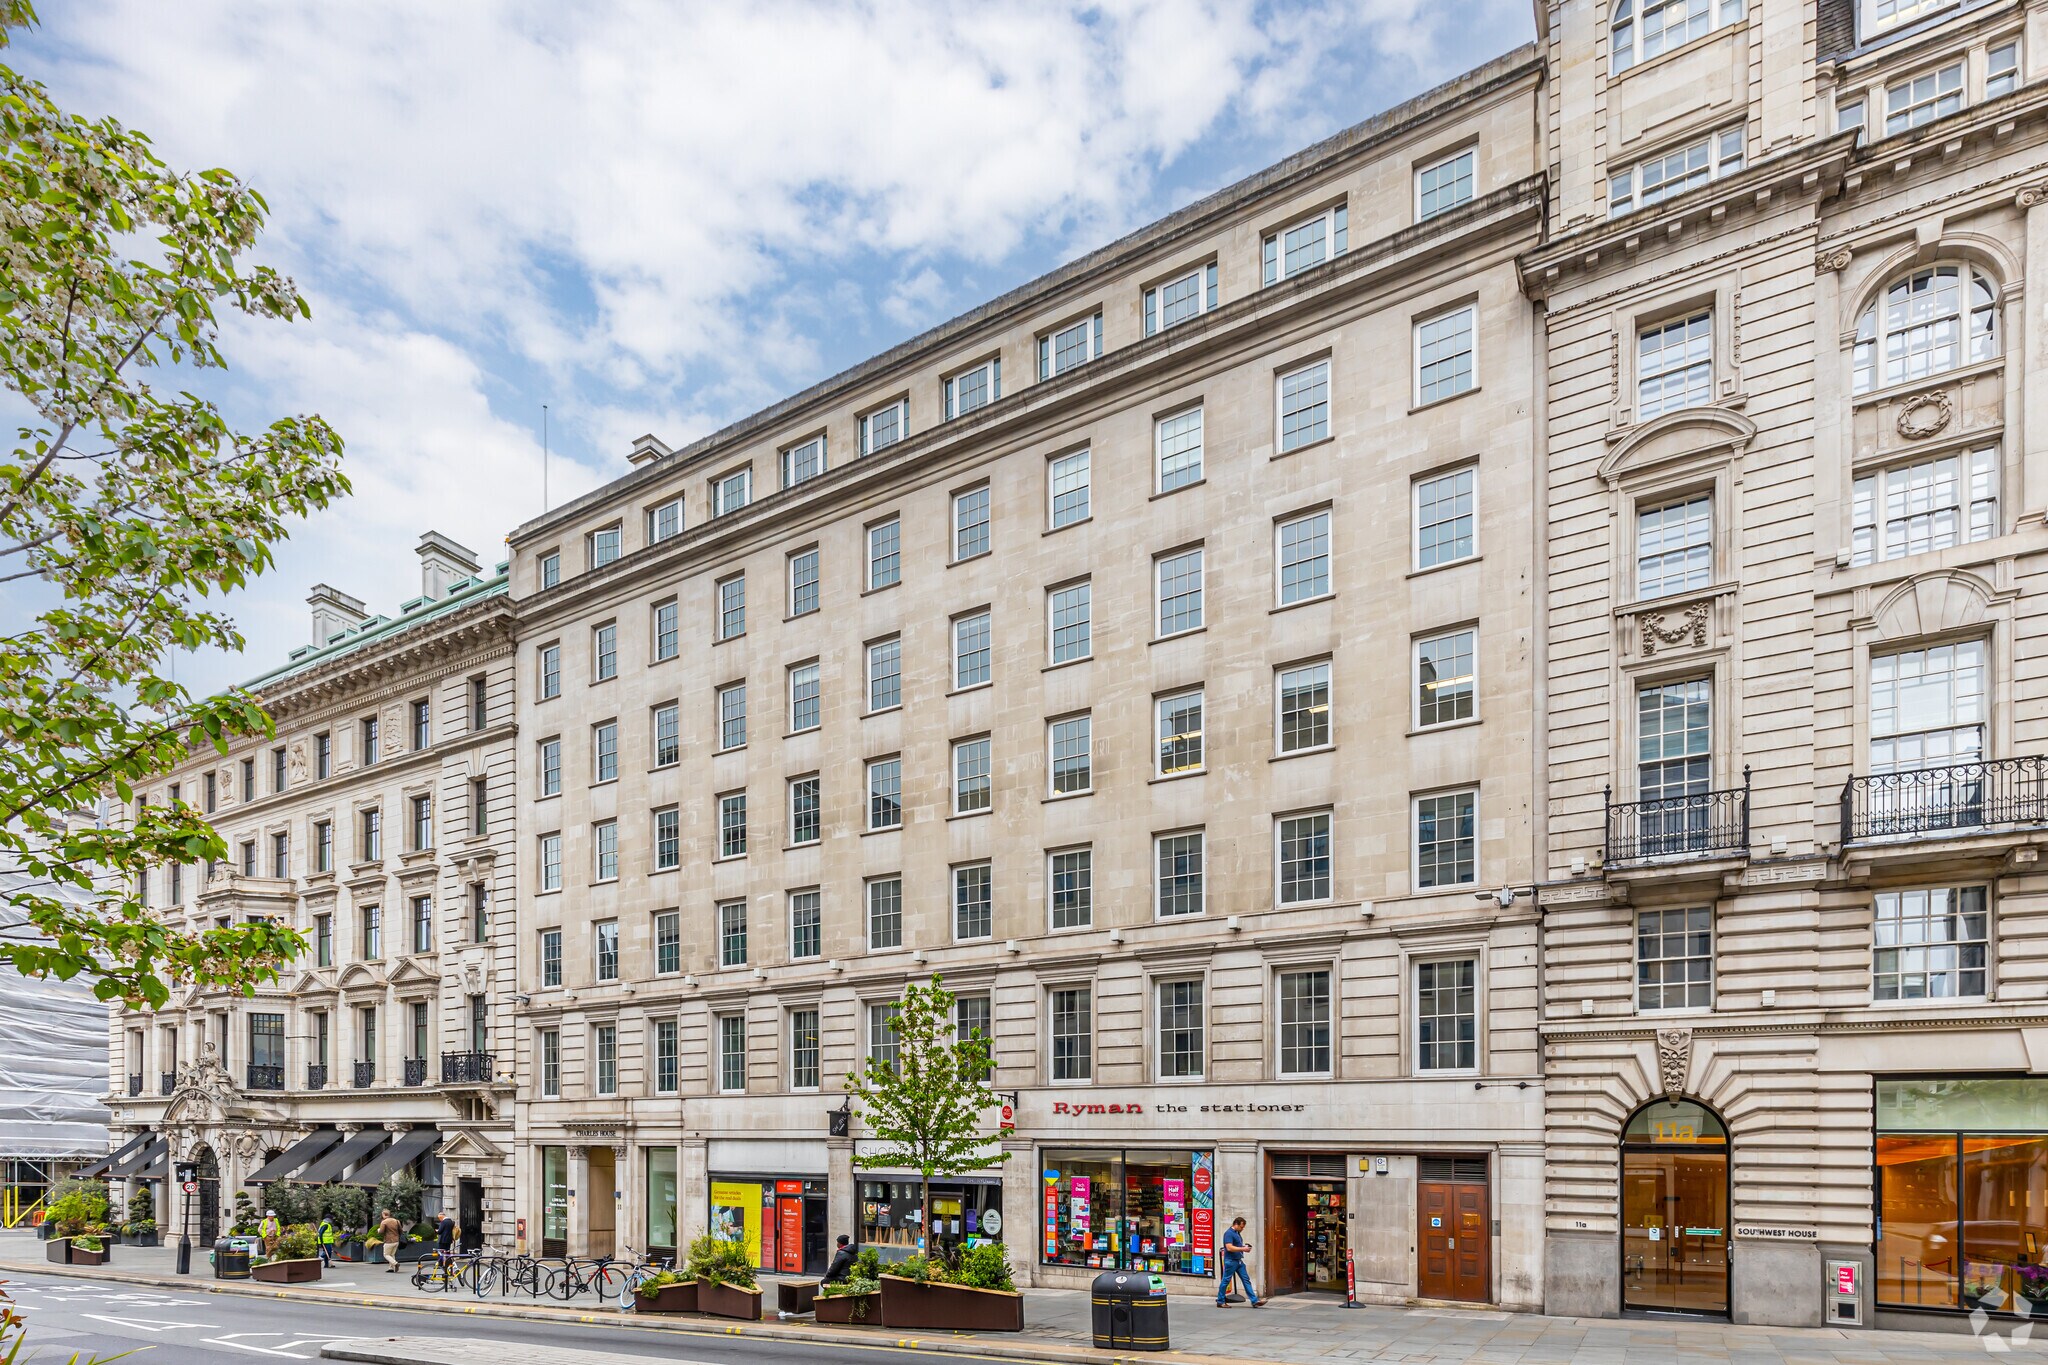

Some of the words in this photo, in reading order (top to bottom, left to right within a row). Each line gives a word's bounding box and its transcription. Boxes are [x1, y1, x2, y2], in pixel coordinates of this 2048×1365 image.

[1052, 1102, 1143, 1117] Ryman
[1155, 1103, 1187, 1113] the
[1200, 1103, 1306, 1113] stationer
[600, 1130, 617, 1138] HOUSE
[1654, 1120, 1695, 1141] 11a
[1788, 1230, 1817, 1238] HOUSE
